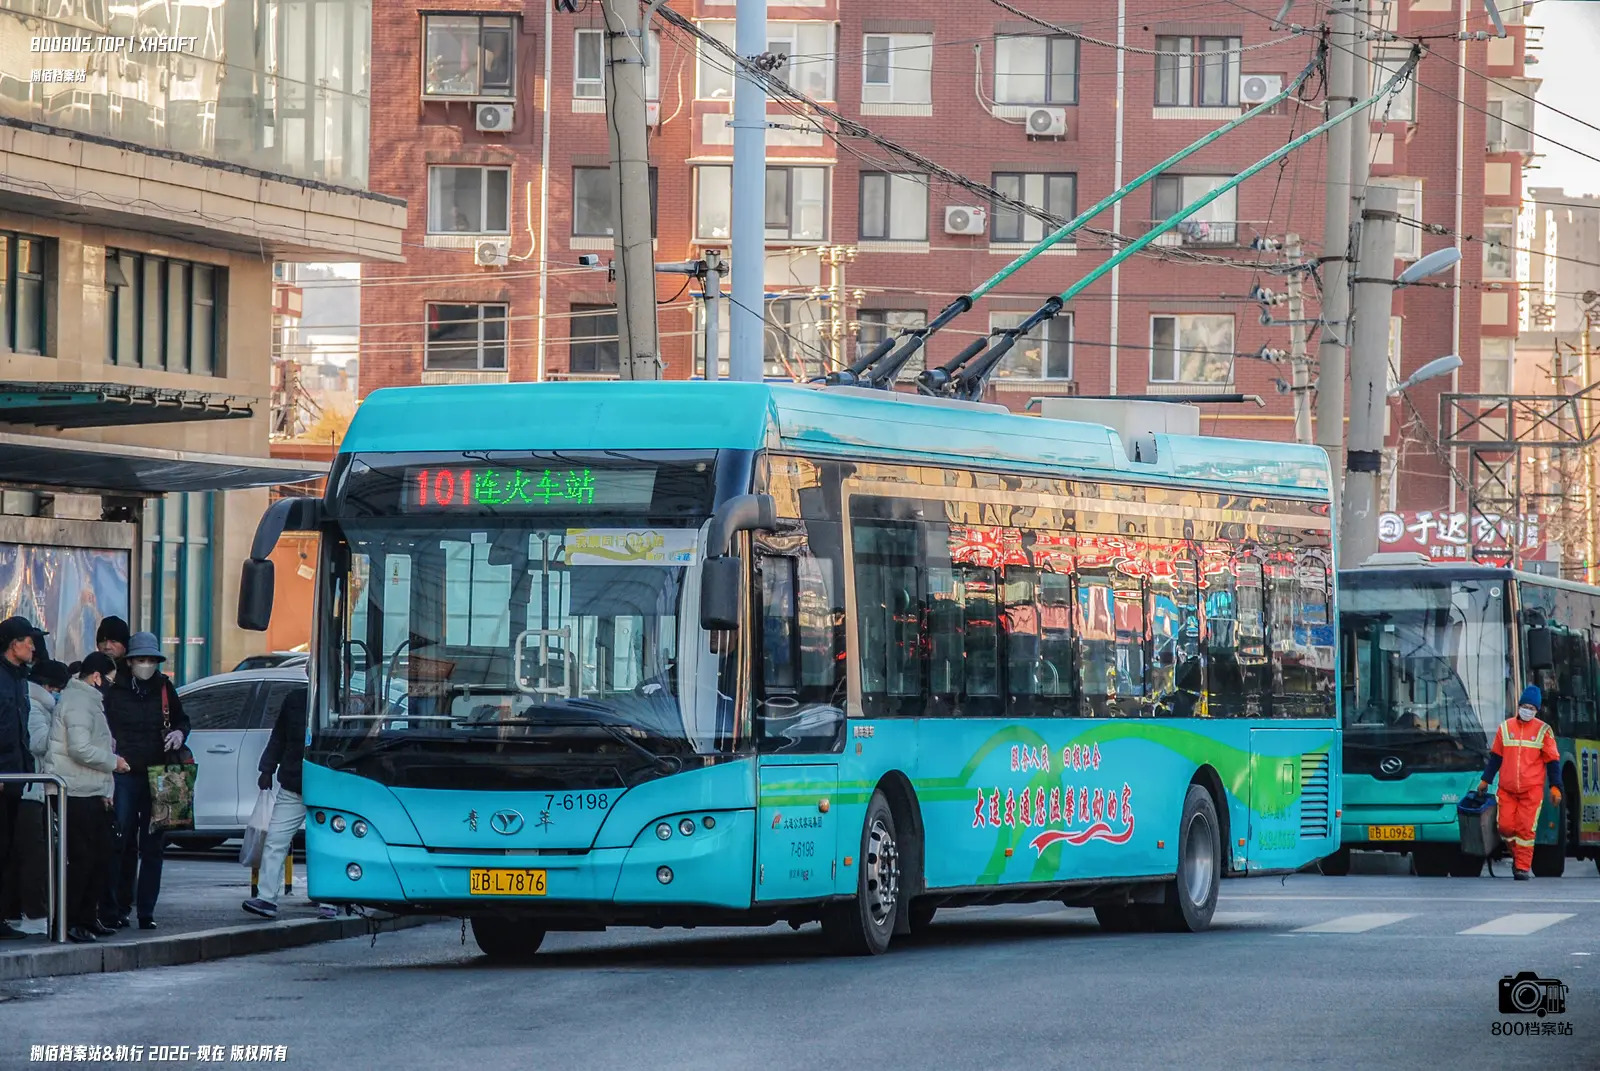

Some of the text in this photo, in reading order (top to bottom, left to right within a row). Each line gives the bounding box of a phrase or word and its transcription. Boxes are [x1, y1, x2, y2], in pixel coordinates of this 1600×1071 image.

[416, 469, 595, 506] 101 连火车站
[1011, 741, 1101, 772] 服务人民 回报社会
[545, 793, 608, 810] 7-6198
[972, 782, 1132, 828] 大连交通您温馨流动的家
[791, 841, 815, 857] 7-6198
